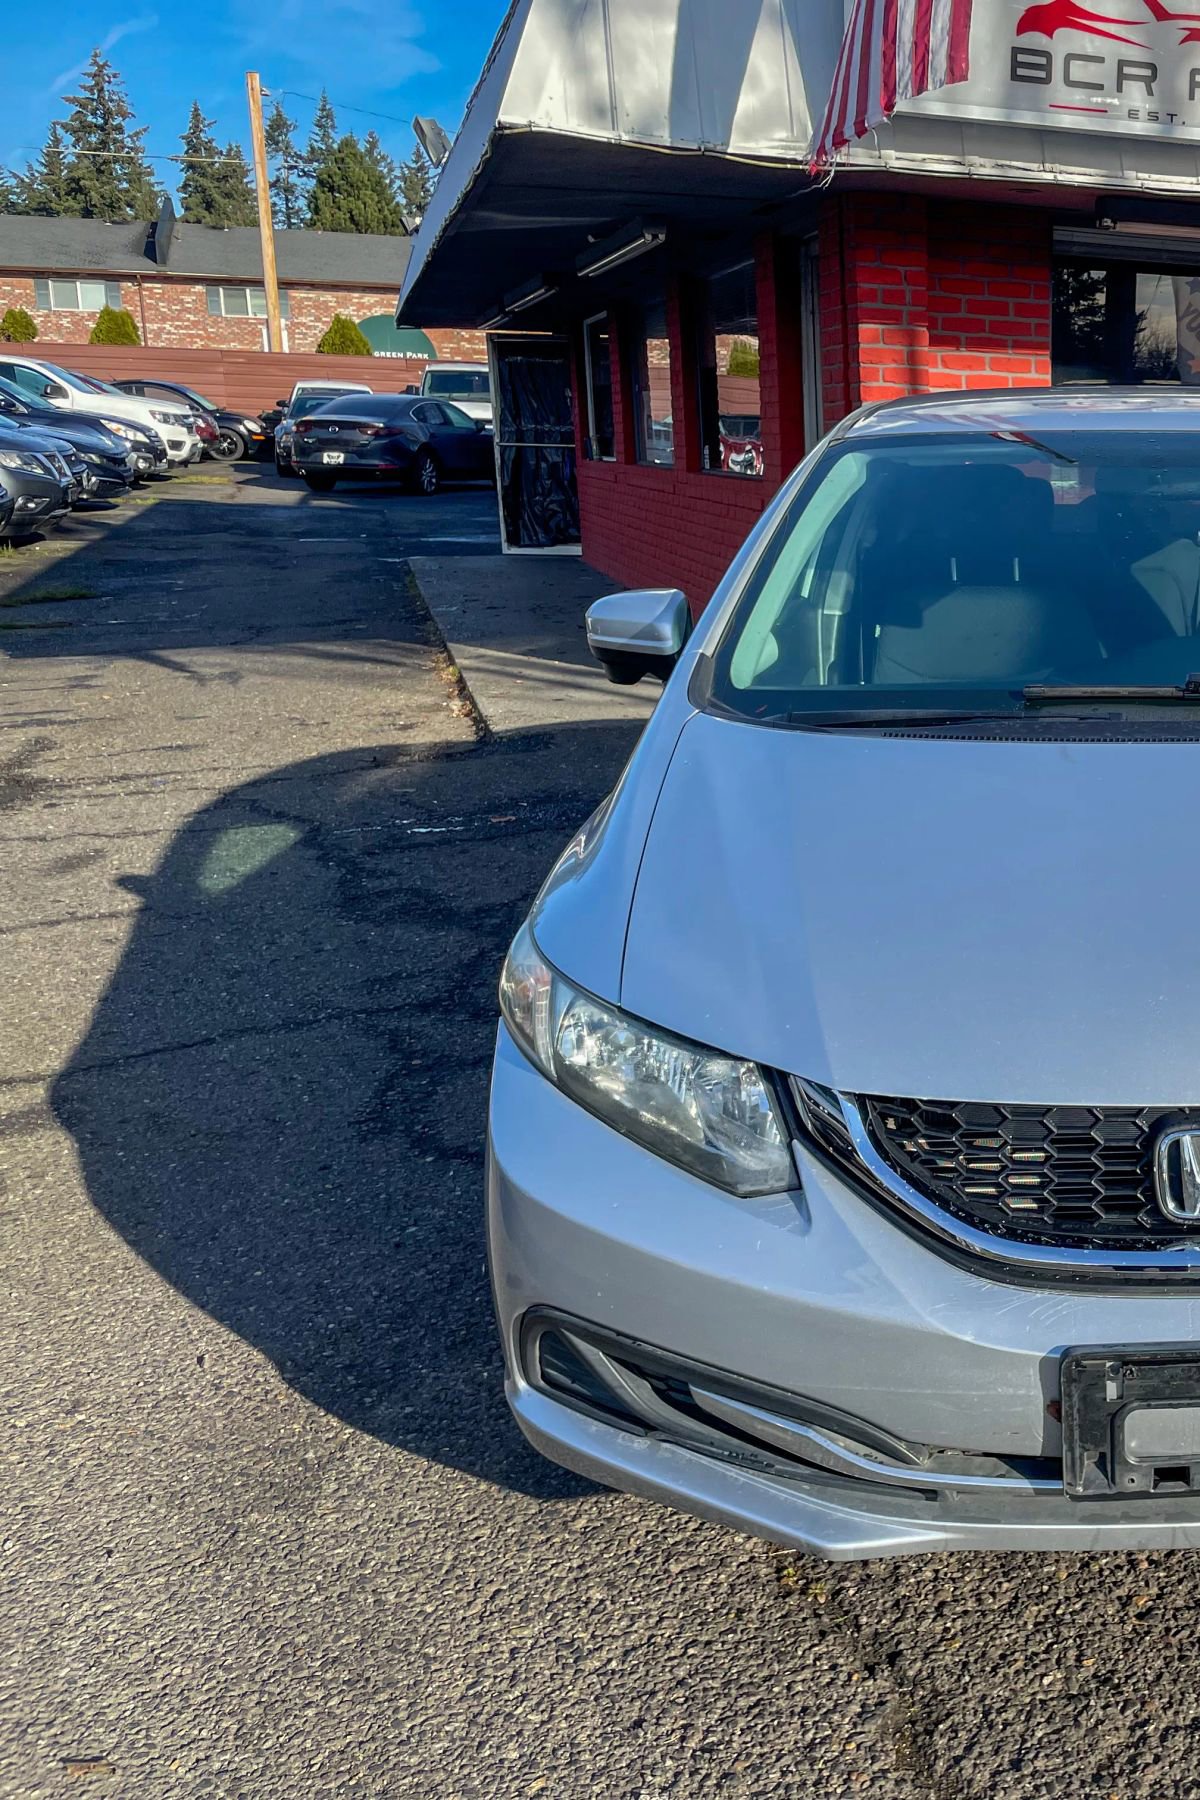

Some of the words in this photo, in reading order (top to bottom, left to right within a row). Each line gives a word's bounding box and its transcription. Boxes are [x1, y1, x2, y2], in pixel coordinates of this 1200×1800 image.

[1010, 46, 1158, 97] BCR
[1127, 108, 1187, 126] EST.
[373, 351, 404, 359] GREEN
